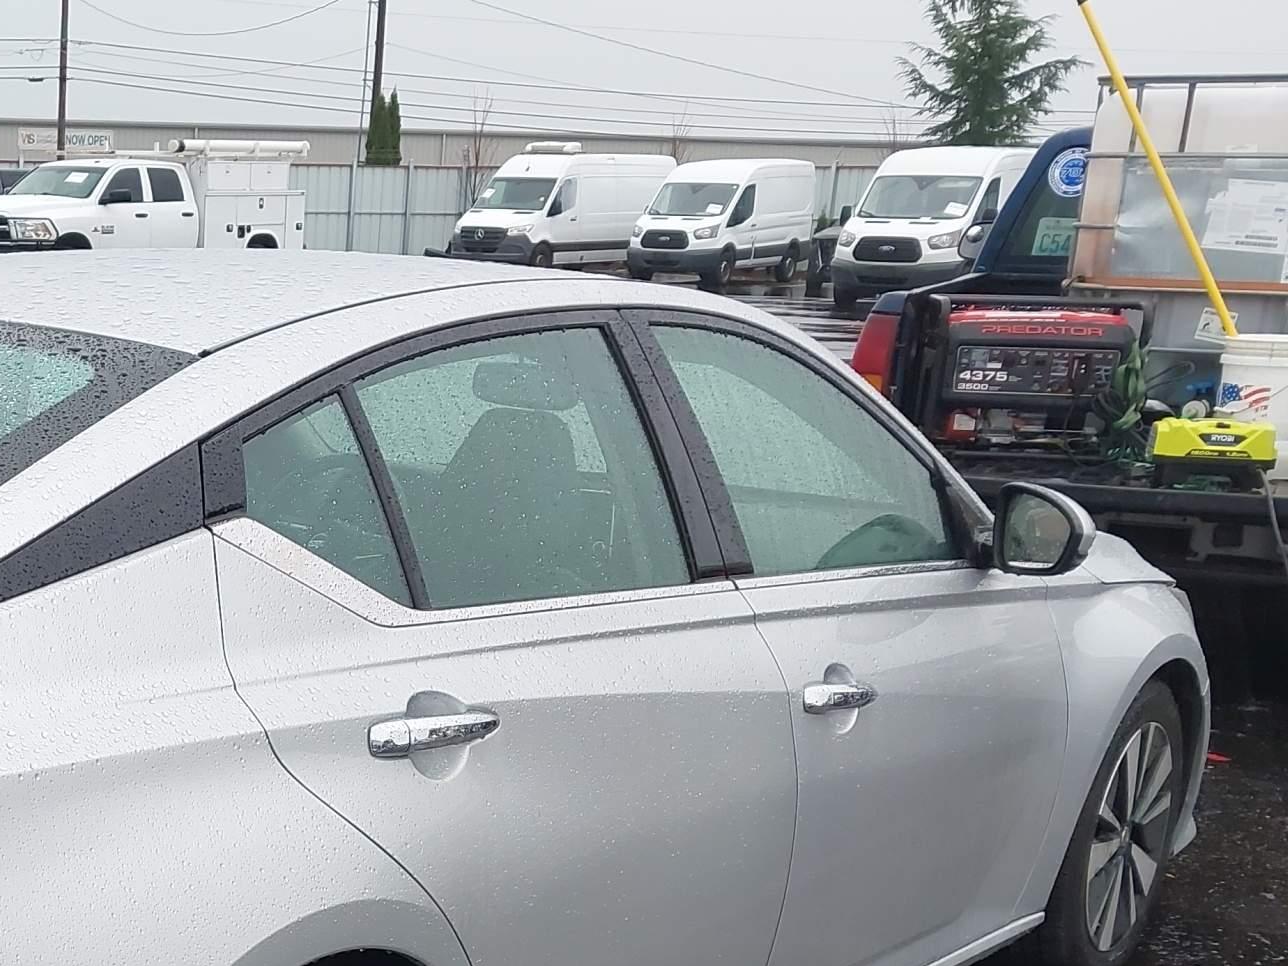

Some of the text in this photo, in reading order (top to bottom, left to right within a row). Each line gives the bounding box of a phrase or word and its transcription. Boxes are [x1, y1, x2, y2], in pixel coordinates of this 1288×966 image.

[66, 134, 86, 146] NOW
[87, 135, 111, 146] OPEN
[981, 324, 1104, 337] PREDATOR
[959, 370, 1009, 382] 4375
[957, 382, 989, 391] 3500
[1210, 433, 1235, 443] RYOBI
